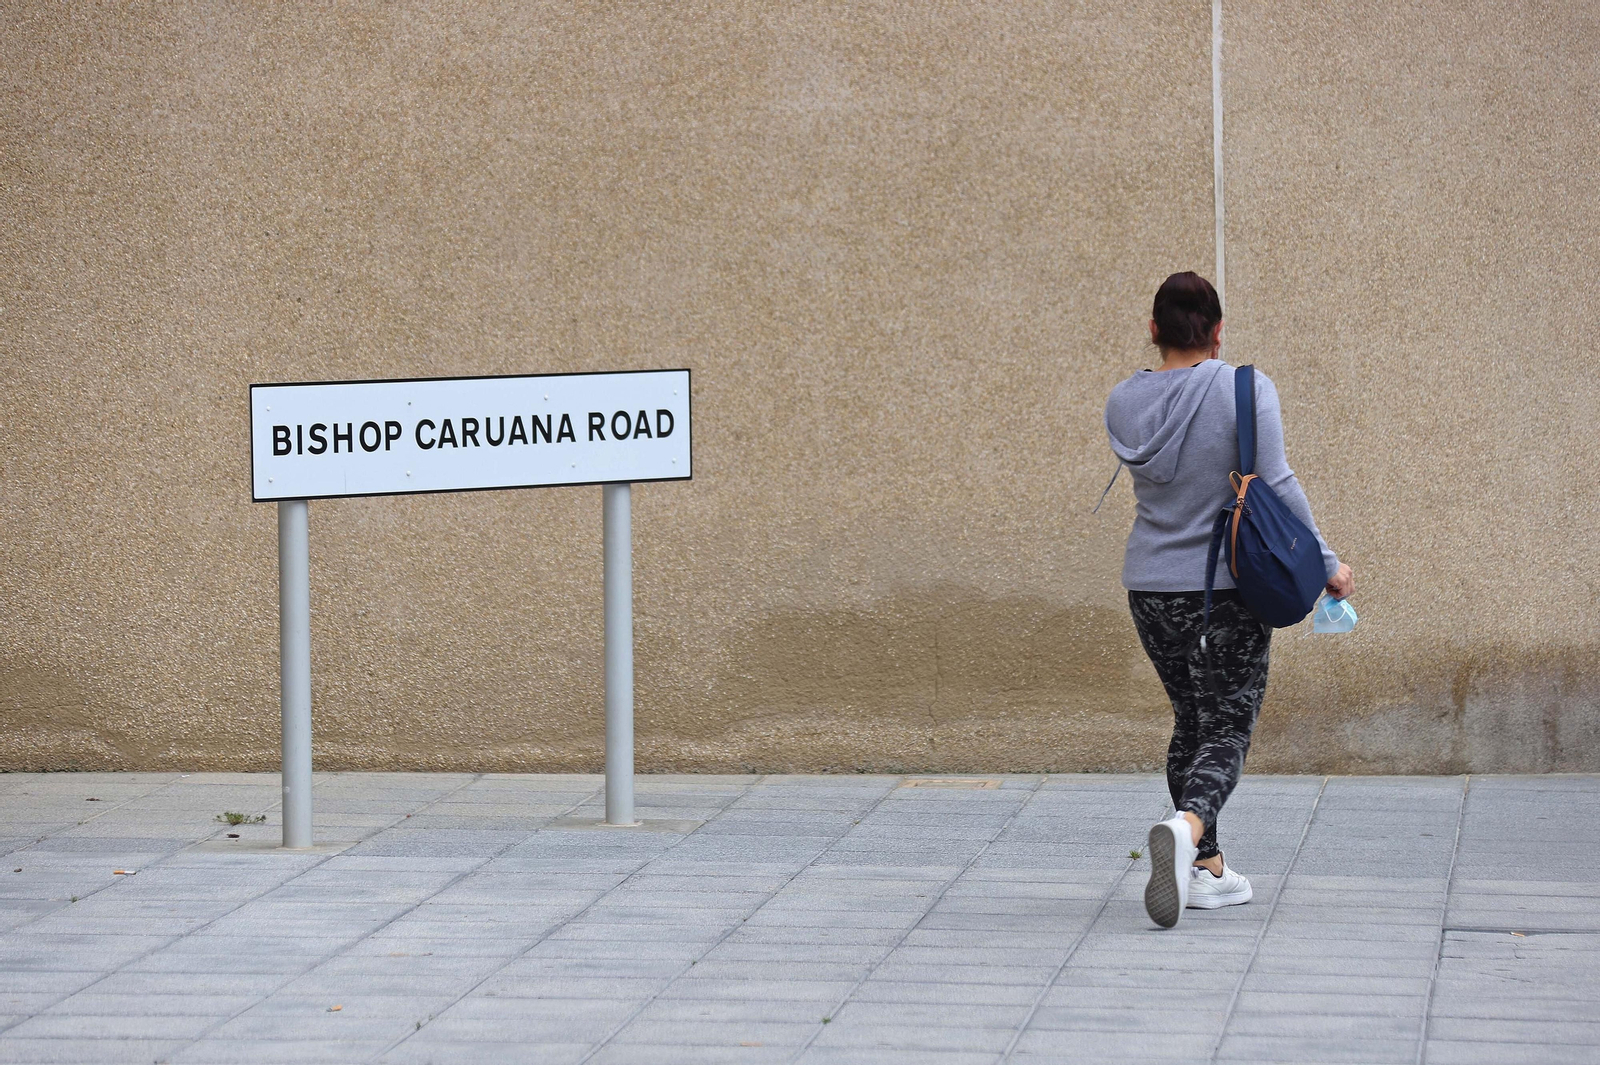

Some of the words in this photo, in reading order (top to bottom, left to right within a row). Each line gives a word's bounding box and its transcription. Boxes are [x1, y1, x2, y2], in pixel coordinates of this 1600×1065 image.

[272, 420, 403, 457] BISHOP
[415, 413, 577, 450] CARUANA
[588, 408, 675, 442] ROAD
